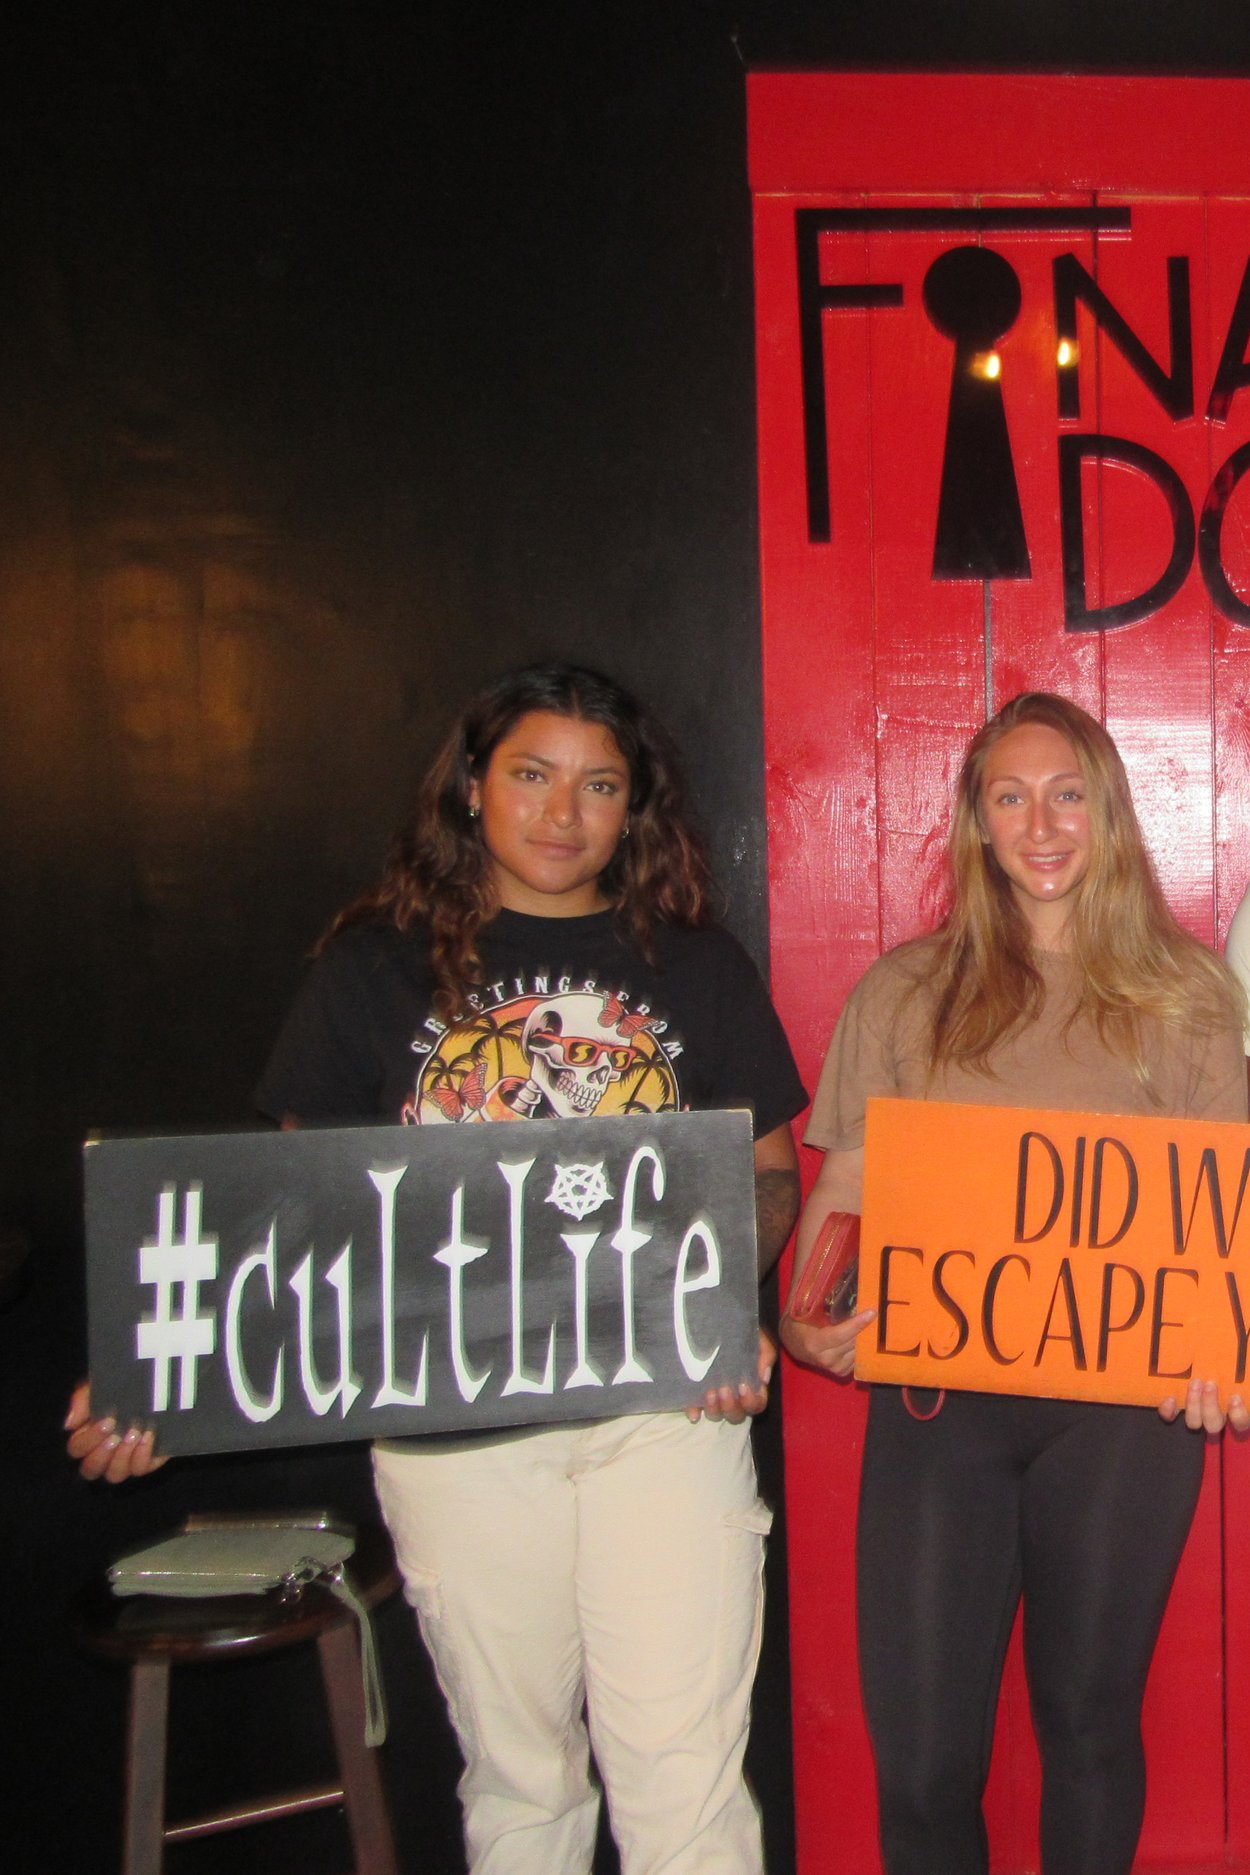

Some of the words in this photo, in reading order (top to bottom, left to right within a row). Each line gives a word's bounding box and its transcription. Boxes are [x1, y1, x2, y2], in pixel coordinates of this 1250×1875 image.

[410, 975, 596, 1054] GRETINGS
[1013, 1131, 1140, 1249] DID
[876, 1245, 1199, 1380] ESCAPE
